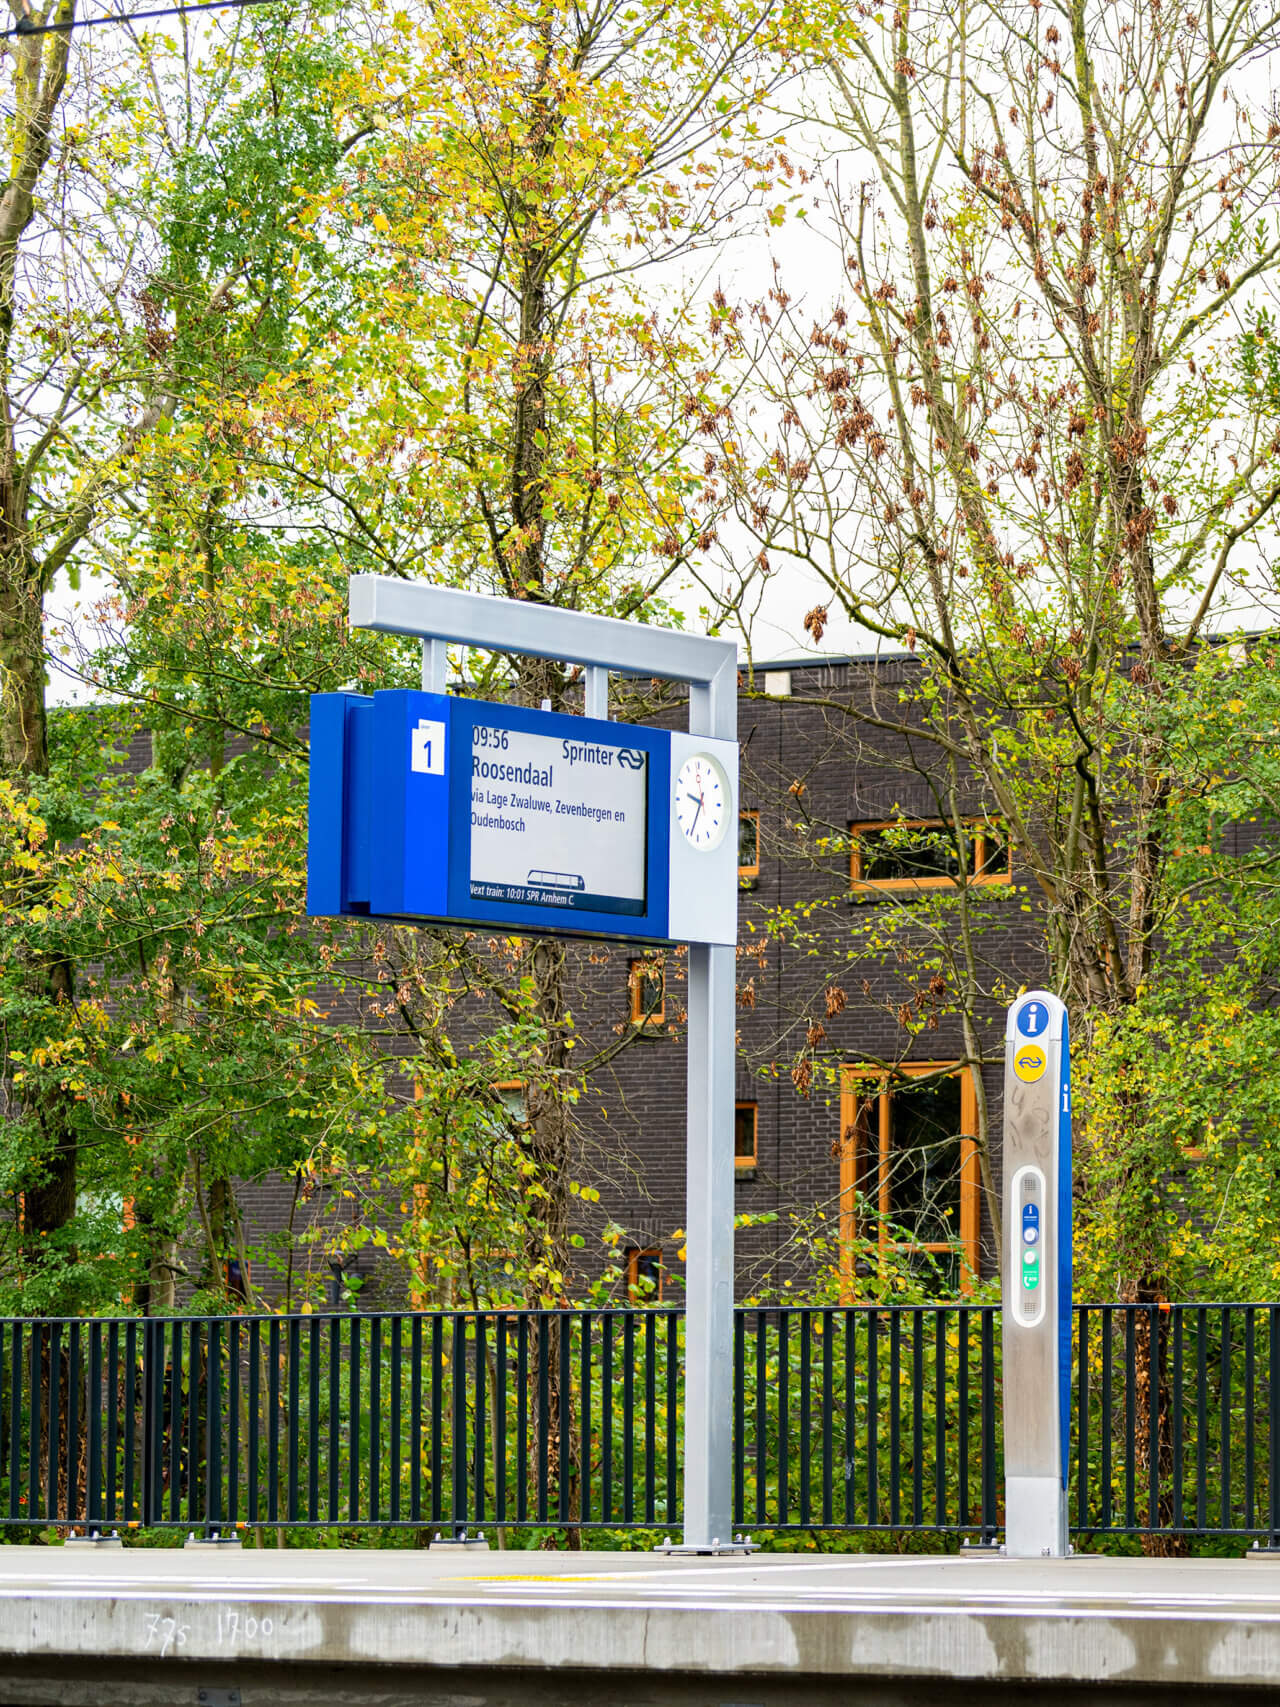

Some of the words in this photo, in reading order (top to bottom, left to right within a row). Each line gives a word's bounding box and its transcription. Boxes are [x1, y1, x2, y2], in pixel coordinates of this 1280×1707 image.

[472, 726, 509, 750] 09:56
[423, 740, 432, 769] 1
[562, 740, 614, 766] Sprinter
[472, 756, 553, 788] Roosendaal
[471, 788, 484, 803] via
[486, 790, 508, 809] Lage
[510, 793, 553, 814] Zwaluwe,
[555, 800, 612, 823] Zevenbergen
[614, 810, 625, 822] en
[471, 812, 526, 832] Oudenbosch
[486, 885, 505, 898] train:
[507, 887, 525, 900] 10:01
[527, 889, 540, 902] SPR
[541, 892, 567, 905] Arnhem
[1027, 1004, 1038, 1033] i
